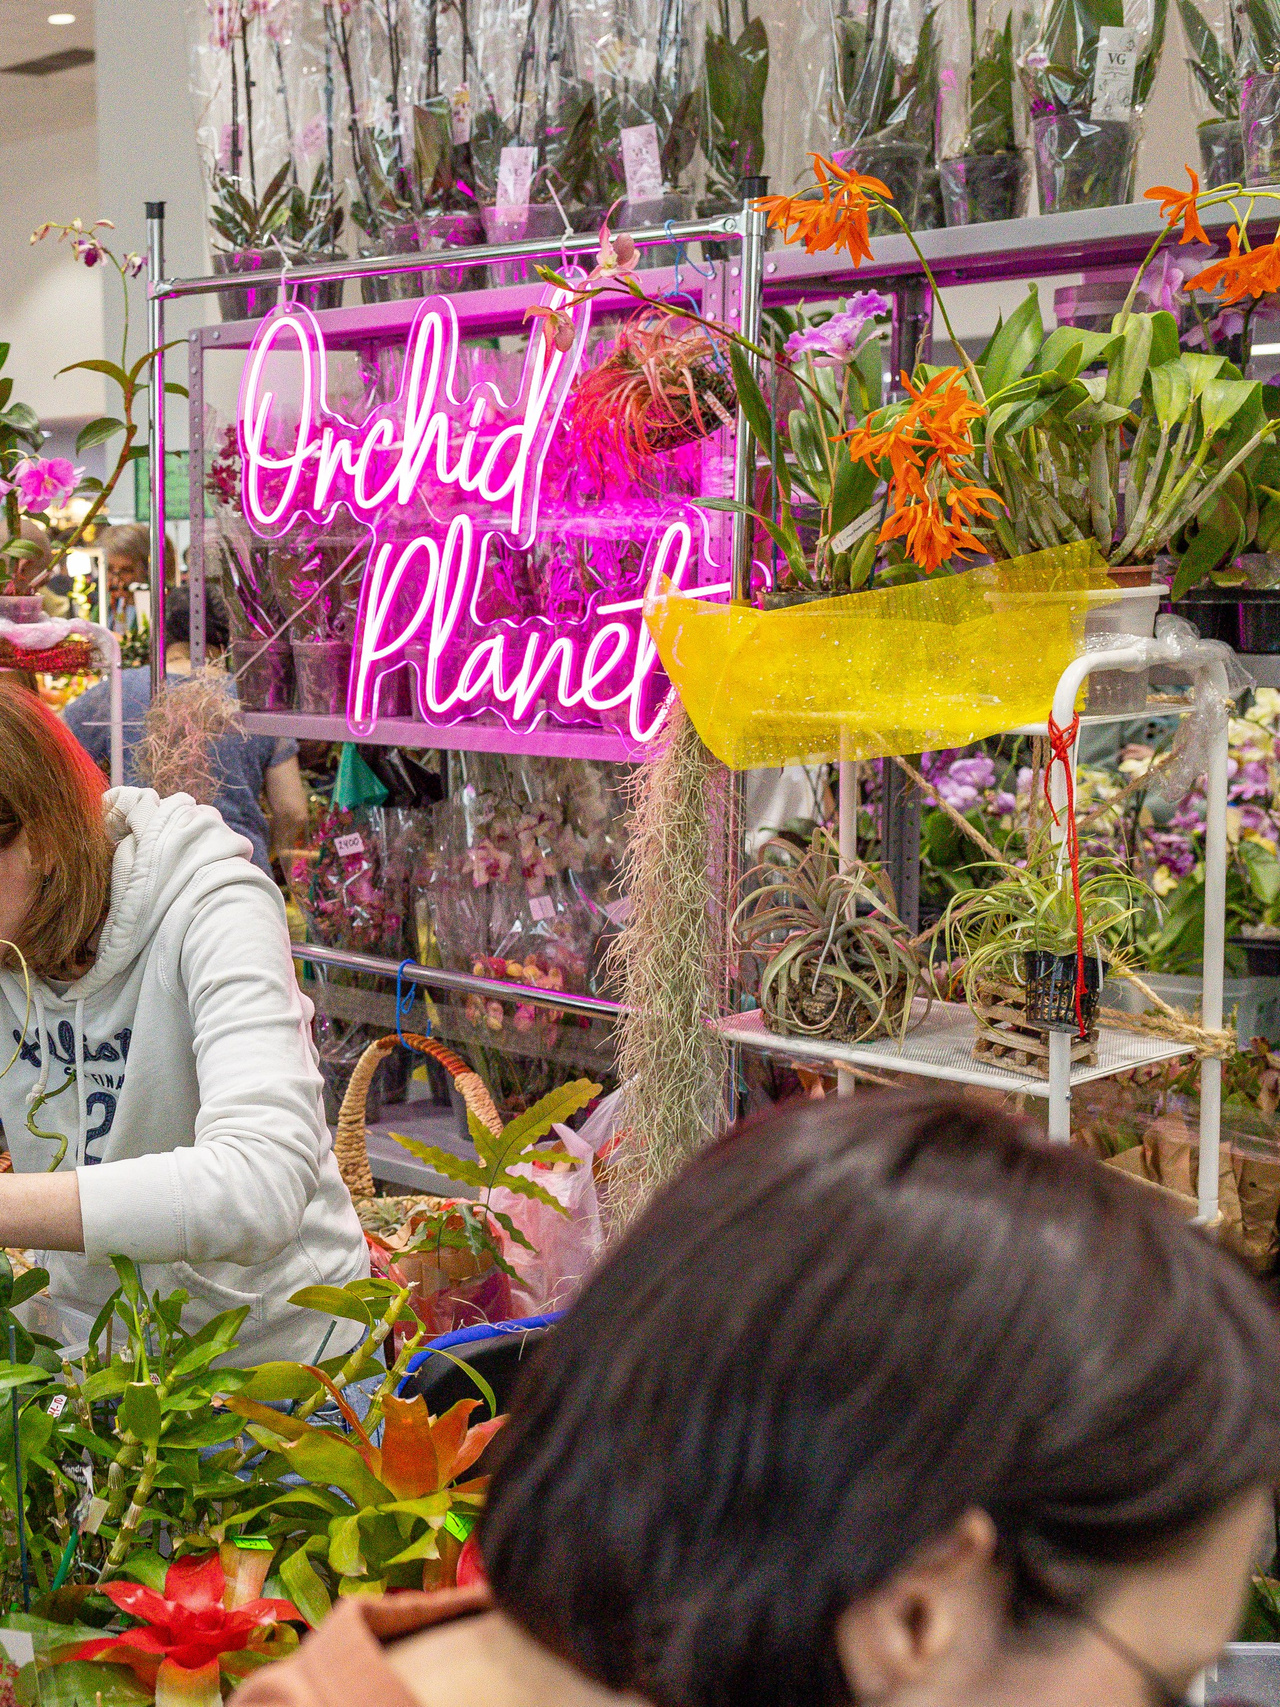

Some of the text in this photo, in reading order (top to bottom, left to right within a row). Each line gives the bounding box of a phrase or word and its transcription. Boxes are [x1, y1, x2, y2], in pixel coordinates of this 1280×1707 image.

[1108, 53, 1127, 65] VG
[243, 281, 576, 534] Orchid
[352, 514, 731, 742] Planet
